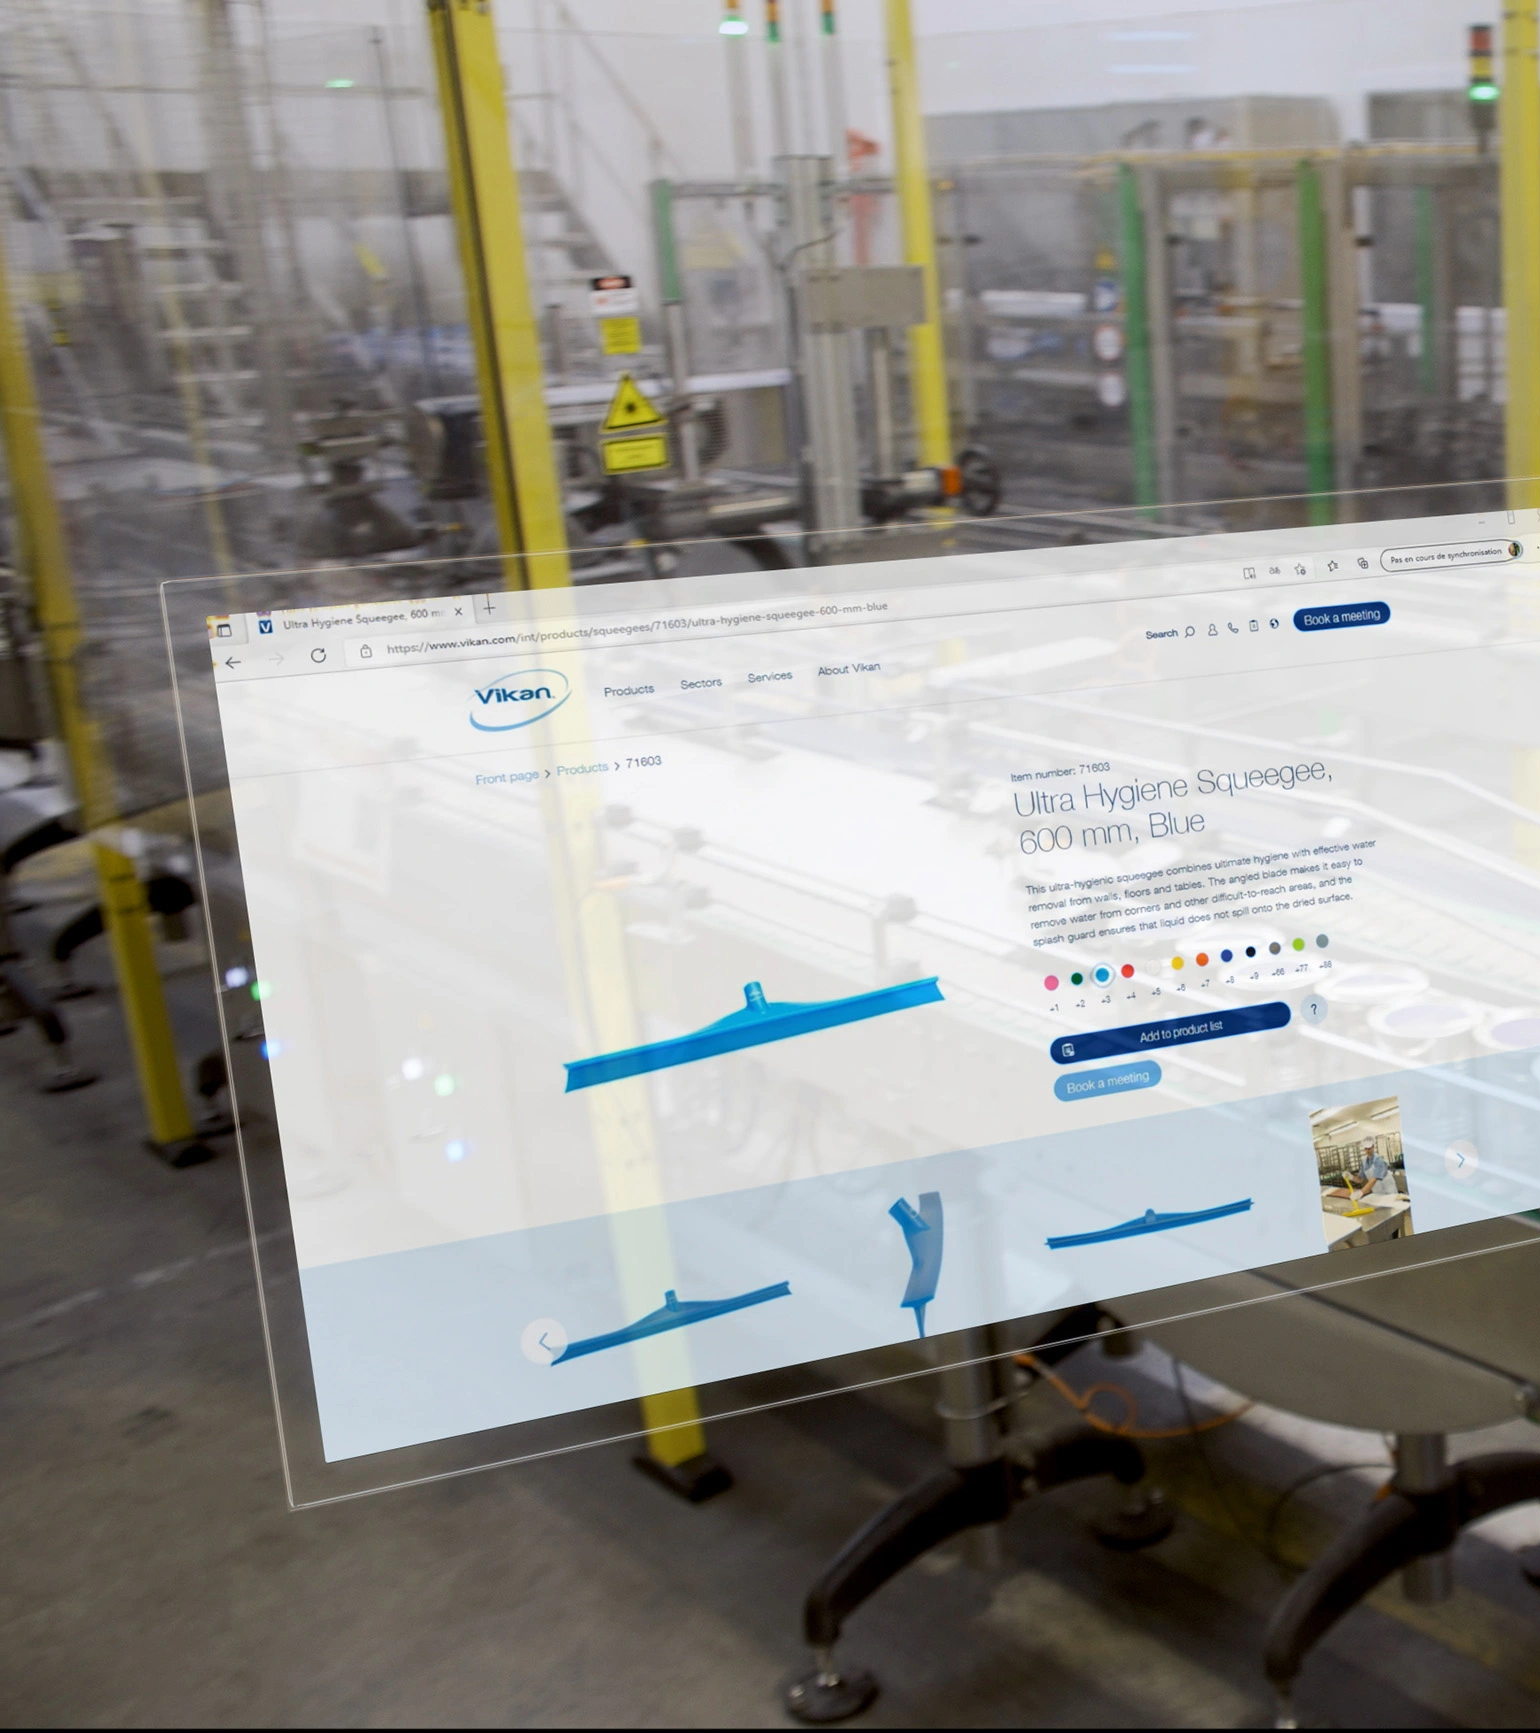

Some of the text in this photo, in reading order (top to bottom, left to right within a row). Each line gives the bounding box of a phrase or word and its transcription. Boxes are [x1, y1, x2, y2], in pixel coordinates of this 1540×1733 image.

[1390, 556, 1402, 564] Pas
[1416, 554, 1435, 562] cours
[1436, 552, 1446, 560] de
[1448, 548, 1502, 563] synchronisation
[283, 619, 308, 630] Ultra
[312, 616, 353, 630] Hygiene
[356, 612, 408, 625] Squeegee,
[410, 609, 428, 620] 600
[1304, 609, 1380, 626] Book a meeting
[387, 602, 888, 655] https://www.vikan.com/int/products/squeegees/71603/ultra-hygiene-squeegee-600-mm-blue
[1146, 628, 1178, 640] Search
[748, 670, 793, 684] Services
[818, 662, 882, 677] About Vikan
[604, 684, 655, 697] Products
[680, 676, 722, 690] Sectors
[474, 686, 552, 705] Vikan
[556, 762, 610, 776] Products
[626, 755, 662, 769] 71603
[475, 769, 540, 786] Front page
[1010, 762, 1111, 783] Item number: 71603
[1013, 761, 1333, 818] Ultra Hygiene Squeegee,
[1020, 810, 1206, 855] 600 mm, Blue
[1025, 840, 1376, 896] This ultra-hygienic squeegee combines ultimate hygiene with effective water
[1028, 857, 1363, 912] removal from walls, floors and tables. The angled blade makes it easy to
[1030, 876, 1352, 930] remove water from corners and other difficult-to-reach areas, and the
[1033, 892, 1354, 948] splash guard ensures that liquid does not spill onto the dried surface.
[1140, 1020, 1223, 1043] Add to product list
[1066, 1071, 1150, 1094] Book a meeting
